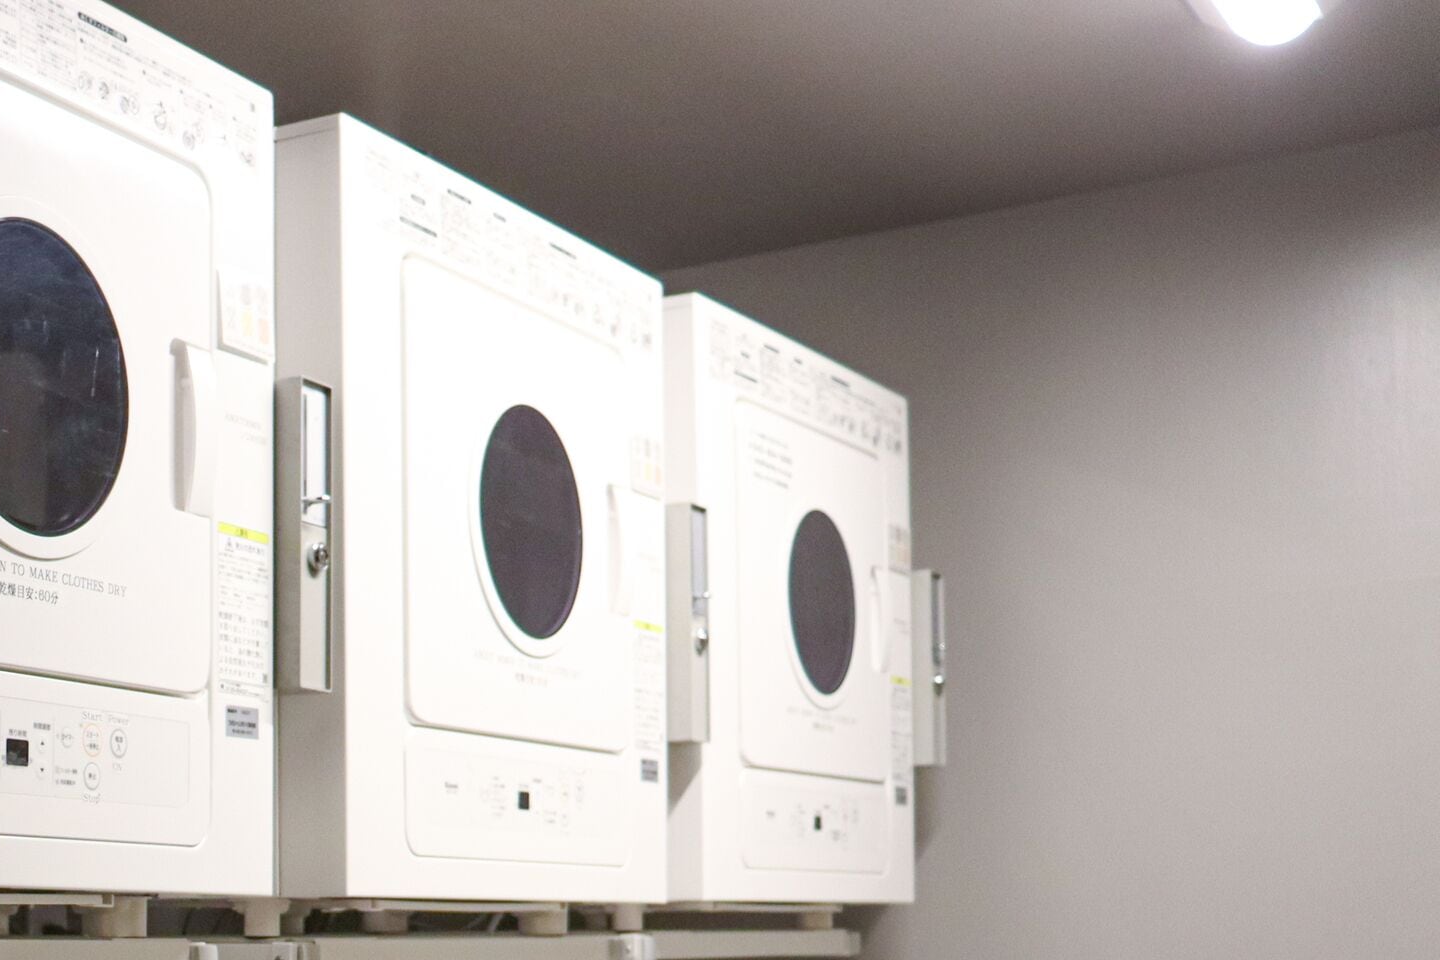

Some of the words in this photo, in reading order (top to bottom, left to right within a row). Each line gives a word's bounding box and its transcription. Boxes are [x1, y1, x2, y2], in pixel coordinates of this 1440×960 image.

[11, 562, 25, 576] TO
[29, 566, 58, 583] MAKE
[61, 573, 104, 593] CLOTHES
[108, 583, 126, 598] DRY
[82, 711, 102, 721] Start
